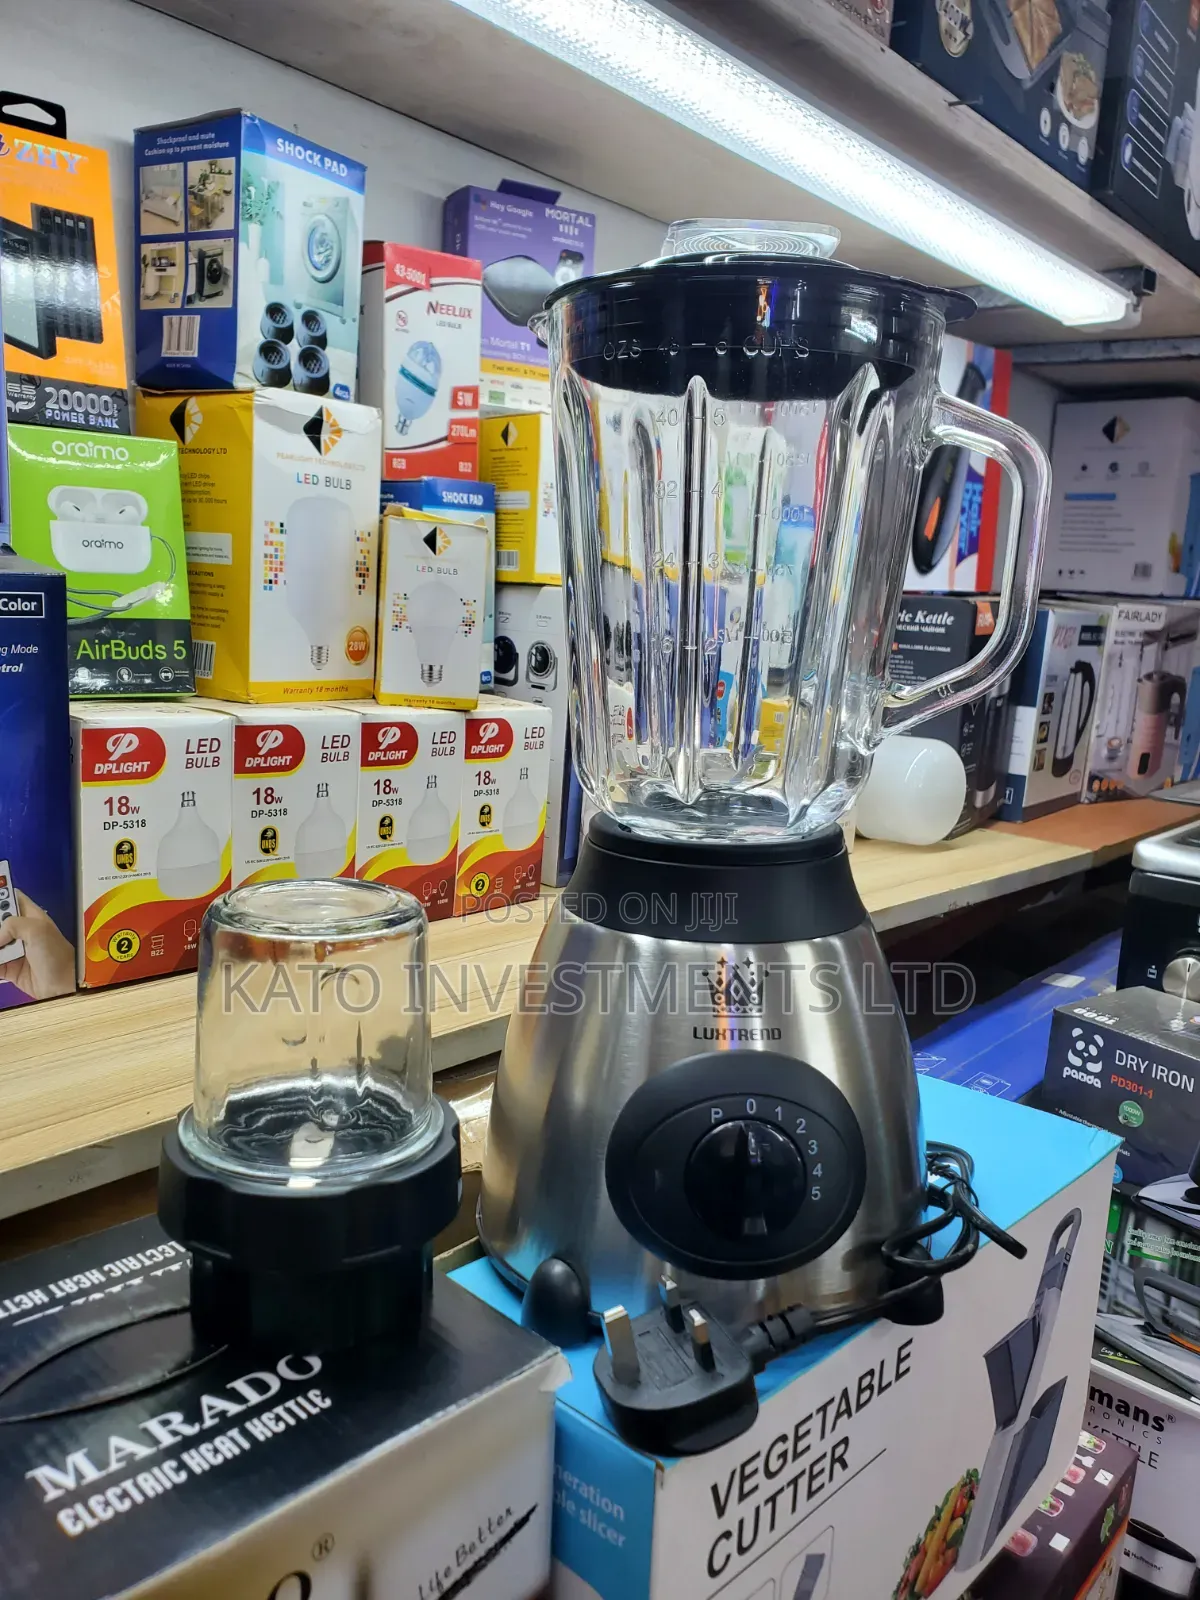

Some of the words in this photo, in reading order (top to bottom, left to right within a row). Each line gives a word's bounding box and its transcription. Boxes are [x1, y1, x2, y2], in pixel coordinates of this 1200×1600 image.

[14, 138, 82, 175] ZHY
[276, 138, 321, 168] SHOCK
[323, 156, 349, 178] PAD
[489, 200, 505, 212] Hey
[506, 204, 534, 217] Google
[545, 207, 593, 228] MORTAL
[426, 300, 473, 319] NEELUX
[44, 386, 113, 416] 20000
[45, 410, 86, 425] POWER
[89, 415, 120, 429] BANK
[52, 439, 129, 462] oraimo
[296, 472, 320, 486] LED
[324, 476, 352, 491] BULB
[442, 491, 468, 505] SHOCK
[469, 494, 484, 506] PAD
[82, 538, 124, 550] oraimo
[416, 564, 433, 574] LED
[436, 566, 459, 576] BULB
[0, 598, 37, 611] Color
[914, 609, 955, 626] Kettle
[1117, 609, 1163, 623] FAIRLADY
[10, 644, 39, 654] Mode
[76, 639, 167, 660] AirBuds
[173, 640, 187, 660] 5
[0, 663, 24, 673] trol
[283, 687, 314, 695] Warranty
[324, 685, 349, 693] months
[431, 731, 457, 745] LED
[524, 726, 545, 740] LED
[185, 738, 221, 755] LED
[321, 734, 350, 750] LED
[470, 744, 504, 755] DPLIGHT
[523, 740, 545, 751] BULB
[320, 751, 350, 763] BULB
[368, 750, 408, 761] DPLIGHT
[431, 746, 456, 758] BULB
[94, 761, 150, 775] DPLIGHT
[185, 756, 221, 769] BULB
[245, 755, 292, 768] DPLIGHT
[473, 788, 500, 797] DP-5318
[371, 798, 403, 808] DP-5318
[250, 808, 288, 819] DP-5318
[103, 819, 147, 831] DP-5318
[477, 880, 483, 889] 2
[120, 939, 129, 951] 2
[150, 949, 164, 957] B22
[693, 1025, 781, 1041] LUXTREND
[1062, 1066, 1102, 1089] panda
[1115, 1049, 1149, 1074] DRY
[1151, 1063, 1195, 1093] IRON
[1110, 1074, 1153, 1100] PD301-1
[746, 1098, 756, 1115] 0
[774, 1106, 783, 1121] 1
[1123, 1105, 1141, 1117] 1000W
[710, 1107, 723, 1124] P
[1058, 1109, 1084, 1123] Adjustable
[795, 1118, 806, 1133] 2
[808, 1139, 818, 1155] 3
[812, 1163, 823, 1178] 4
[811, 1186, 821, 1201] 5
[103, 1240, 188, 1280] LECTRIC
[47, 1268, 107, 1299] HEAT
[25, 1353, 323, 1502] MARADO
[710, 1338, 913, 1520] VEGETABLE
[56, 1459, 189, 1538] ELECTRIC
[181, 1427, 251, 1475] HEAT
[707, 1435, 850, 1579] CUTTER
[579, 1508, 626, 1548] slicer
